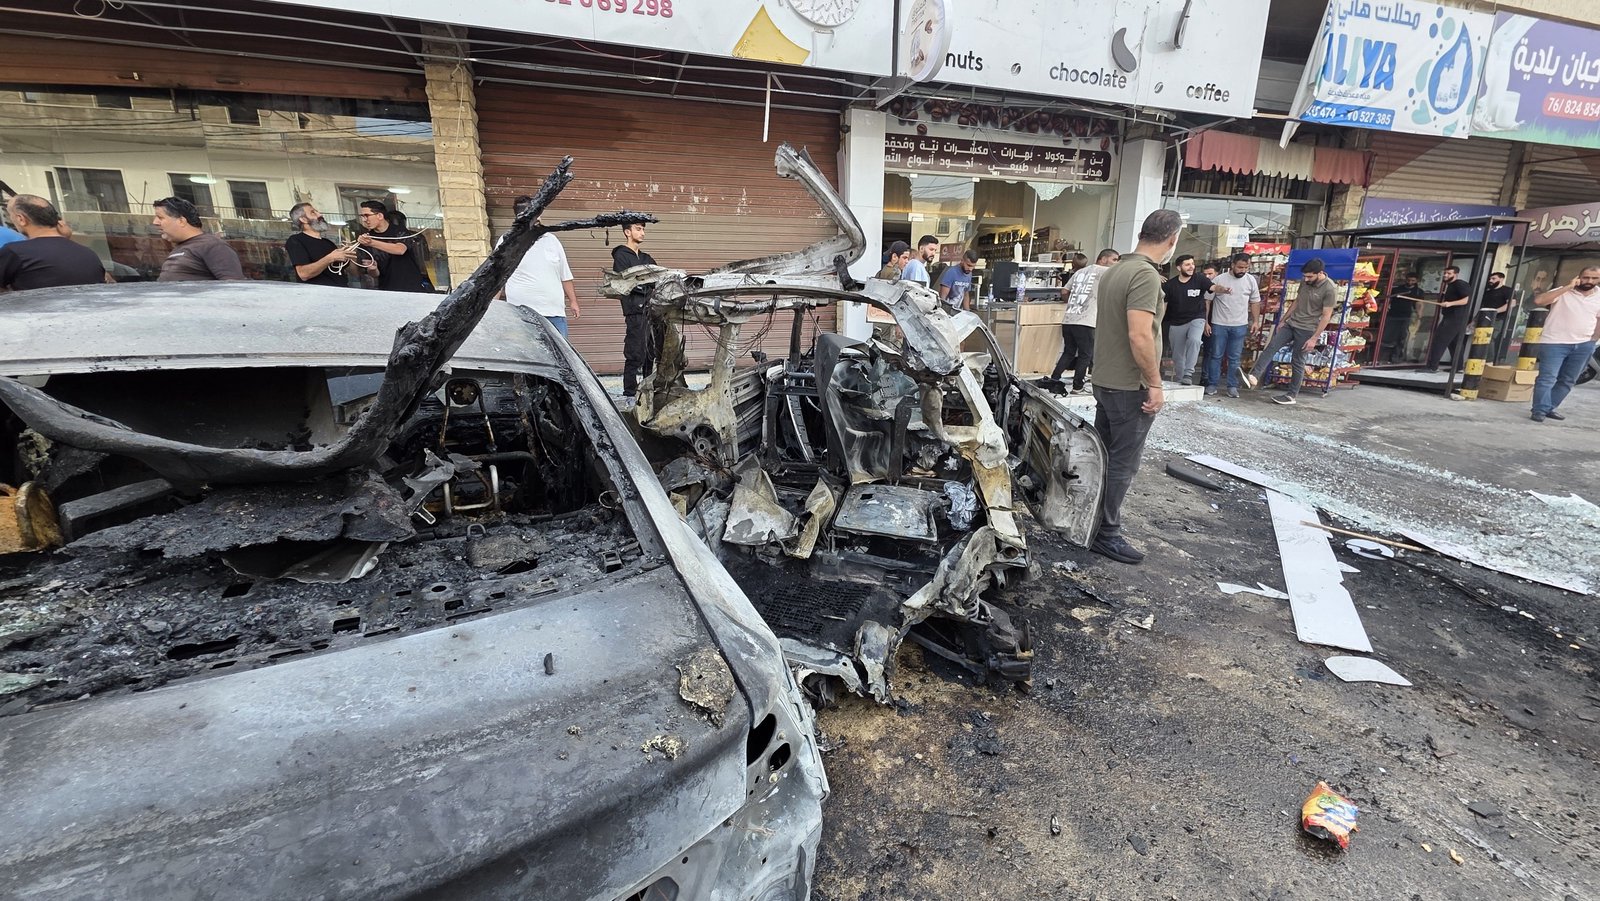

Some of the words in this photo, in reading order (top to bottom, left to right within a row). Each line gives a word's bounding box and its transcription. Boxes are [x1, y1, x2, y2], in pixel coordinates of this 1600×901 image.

[632, 0, 673, 18] 298
[1375, 2, 1421, 30] محلات
[945, 50, 984, 72] nuts
[1514, 37, 1561, 84] بلدية
[1049, 62, 1127, 89] chocolate
[1186, 83, 1230, 103] coffee
[1320, 106, 1337, 119] 474
[1360, 111, 1375, 123] 527
[1376, 113, 1391, 125] 385
[1564, 99, 1582, 115] 824
[1583, 102, 1600, 117] 854
[906, 154, 934, 168] أنواع
[939, 157, 974, 169] أجود
[1001, 147, 1033, 161] بهارات
[988, 163, 1029, 175] طبيعي
[1034, 164, 1058, 174] عسل
[1071, 167, 1103, 178] هدايا
